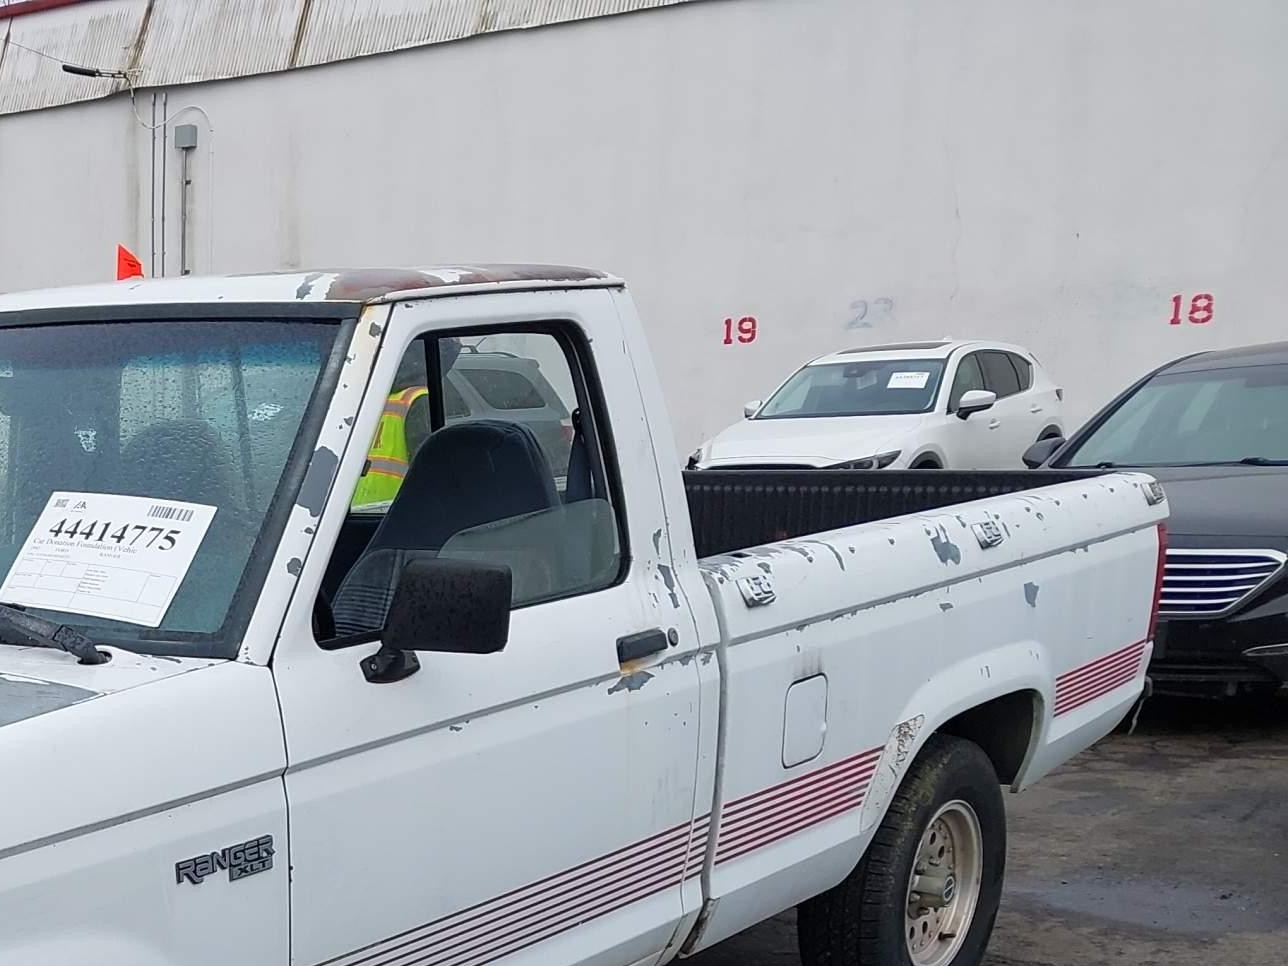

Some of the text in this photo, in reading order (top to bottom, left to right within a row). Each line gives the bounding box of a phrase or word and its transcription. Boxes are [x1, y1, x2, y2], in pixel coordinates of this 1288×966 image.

[1169, 293, 1214, 325] 18
[723, 316, 757, 345] 19
[49, 517, 181, 551] 44414775
[175, 834, 276, 885] RANGER
[237, 858, 270, 877] XLT
